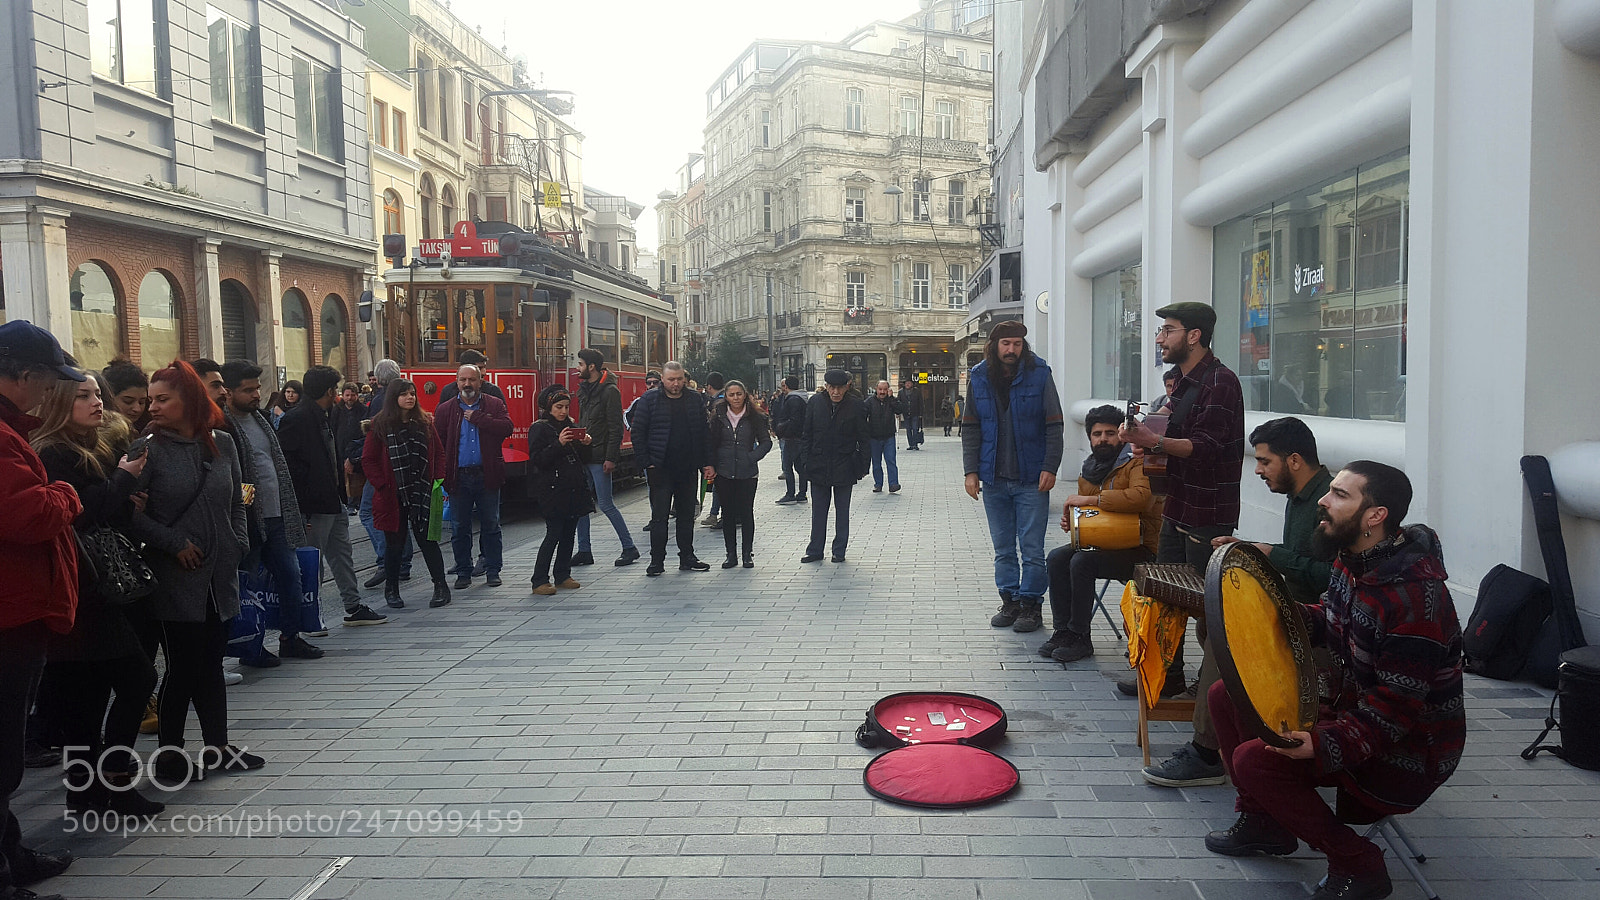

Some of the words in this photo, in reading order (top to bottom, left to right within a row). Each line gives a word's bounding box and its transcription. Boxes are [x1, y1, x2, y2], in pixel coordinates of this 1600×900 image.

[460, 223, 468, 238] 4
[1302, 264, 1324, 287] Ziraat
[506, 384, 524, 399] 115
